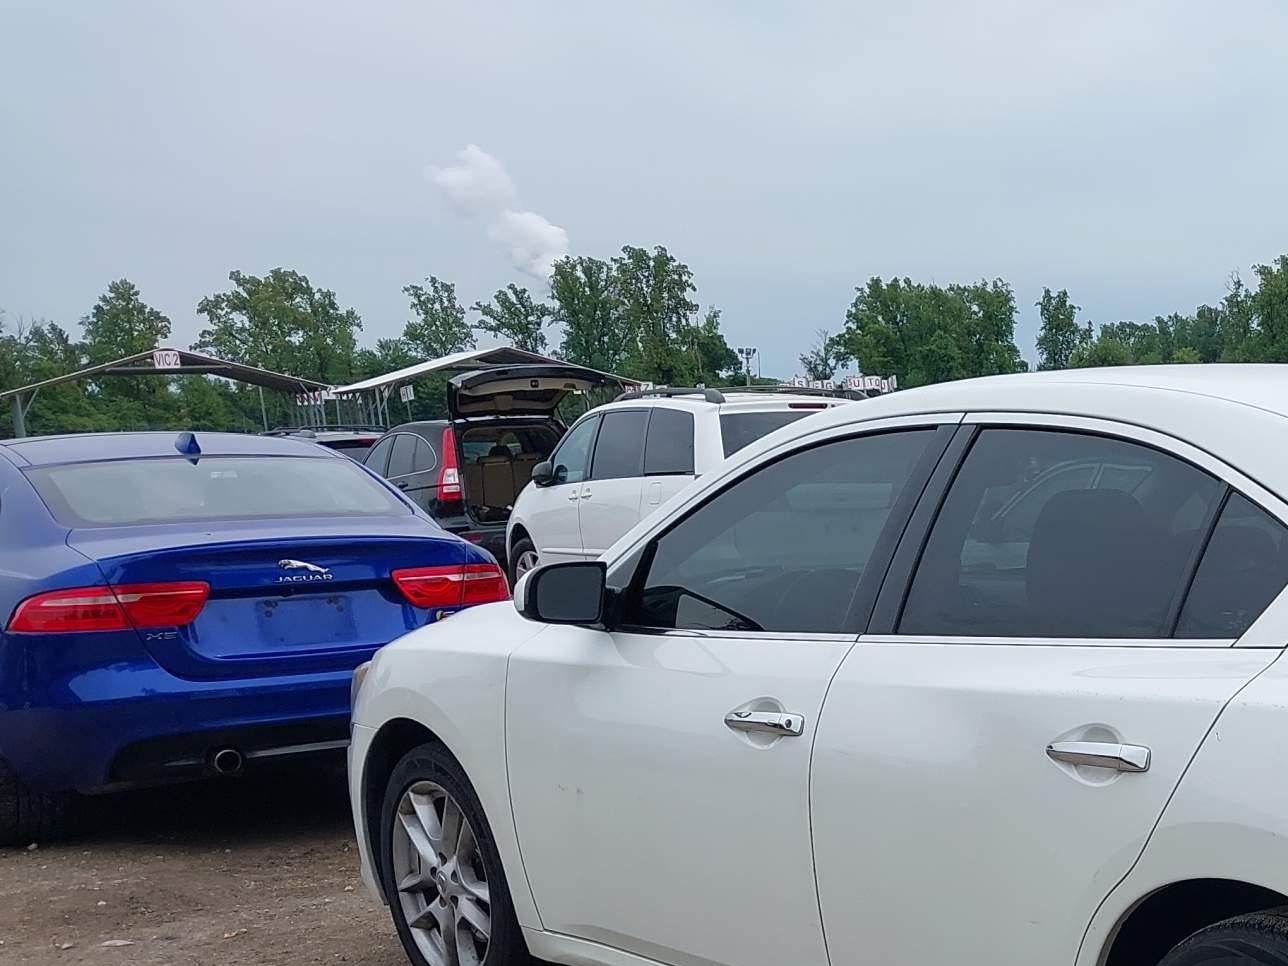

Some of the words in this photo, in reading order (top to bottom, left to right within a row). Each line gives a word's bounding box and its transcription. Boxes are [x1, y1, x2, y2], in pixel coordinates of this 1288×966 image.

[154, 353, 171, 366] VIC
[172, 353, 180, 366] 2
[275, 574, 334, 584] JAGUAR
[146, 631, 177, 641] XE
